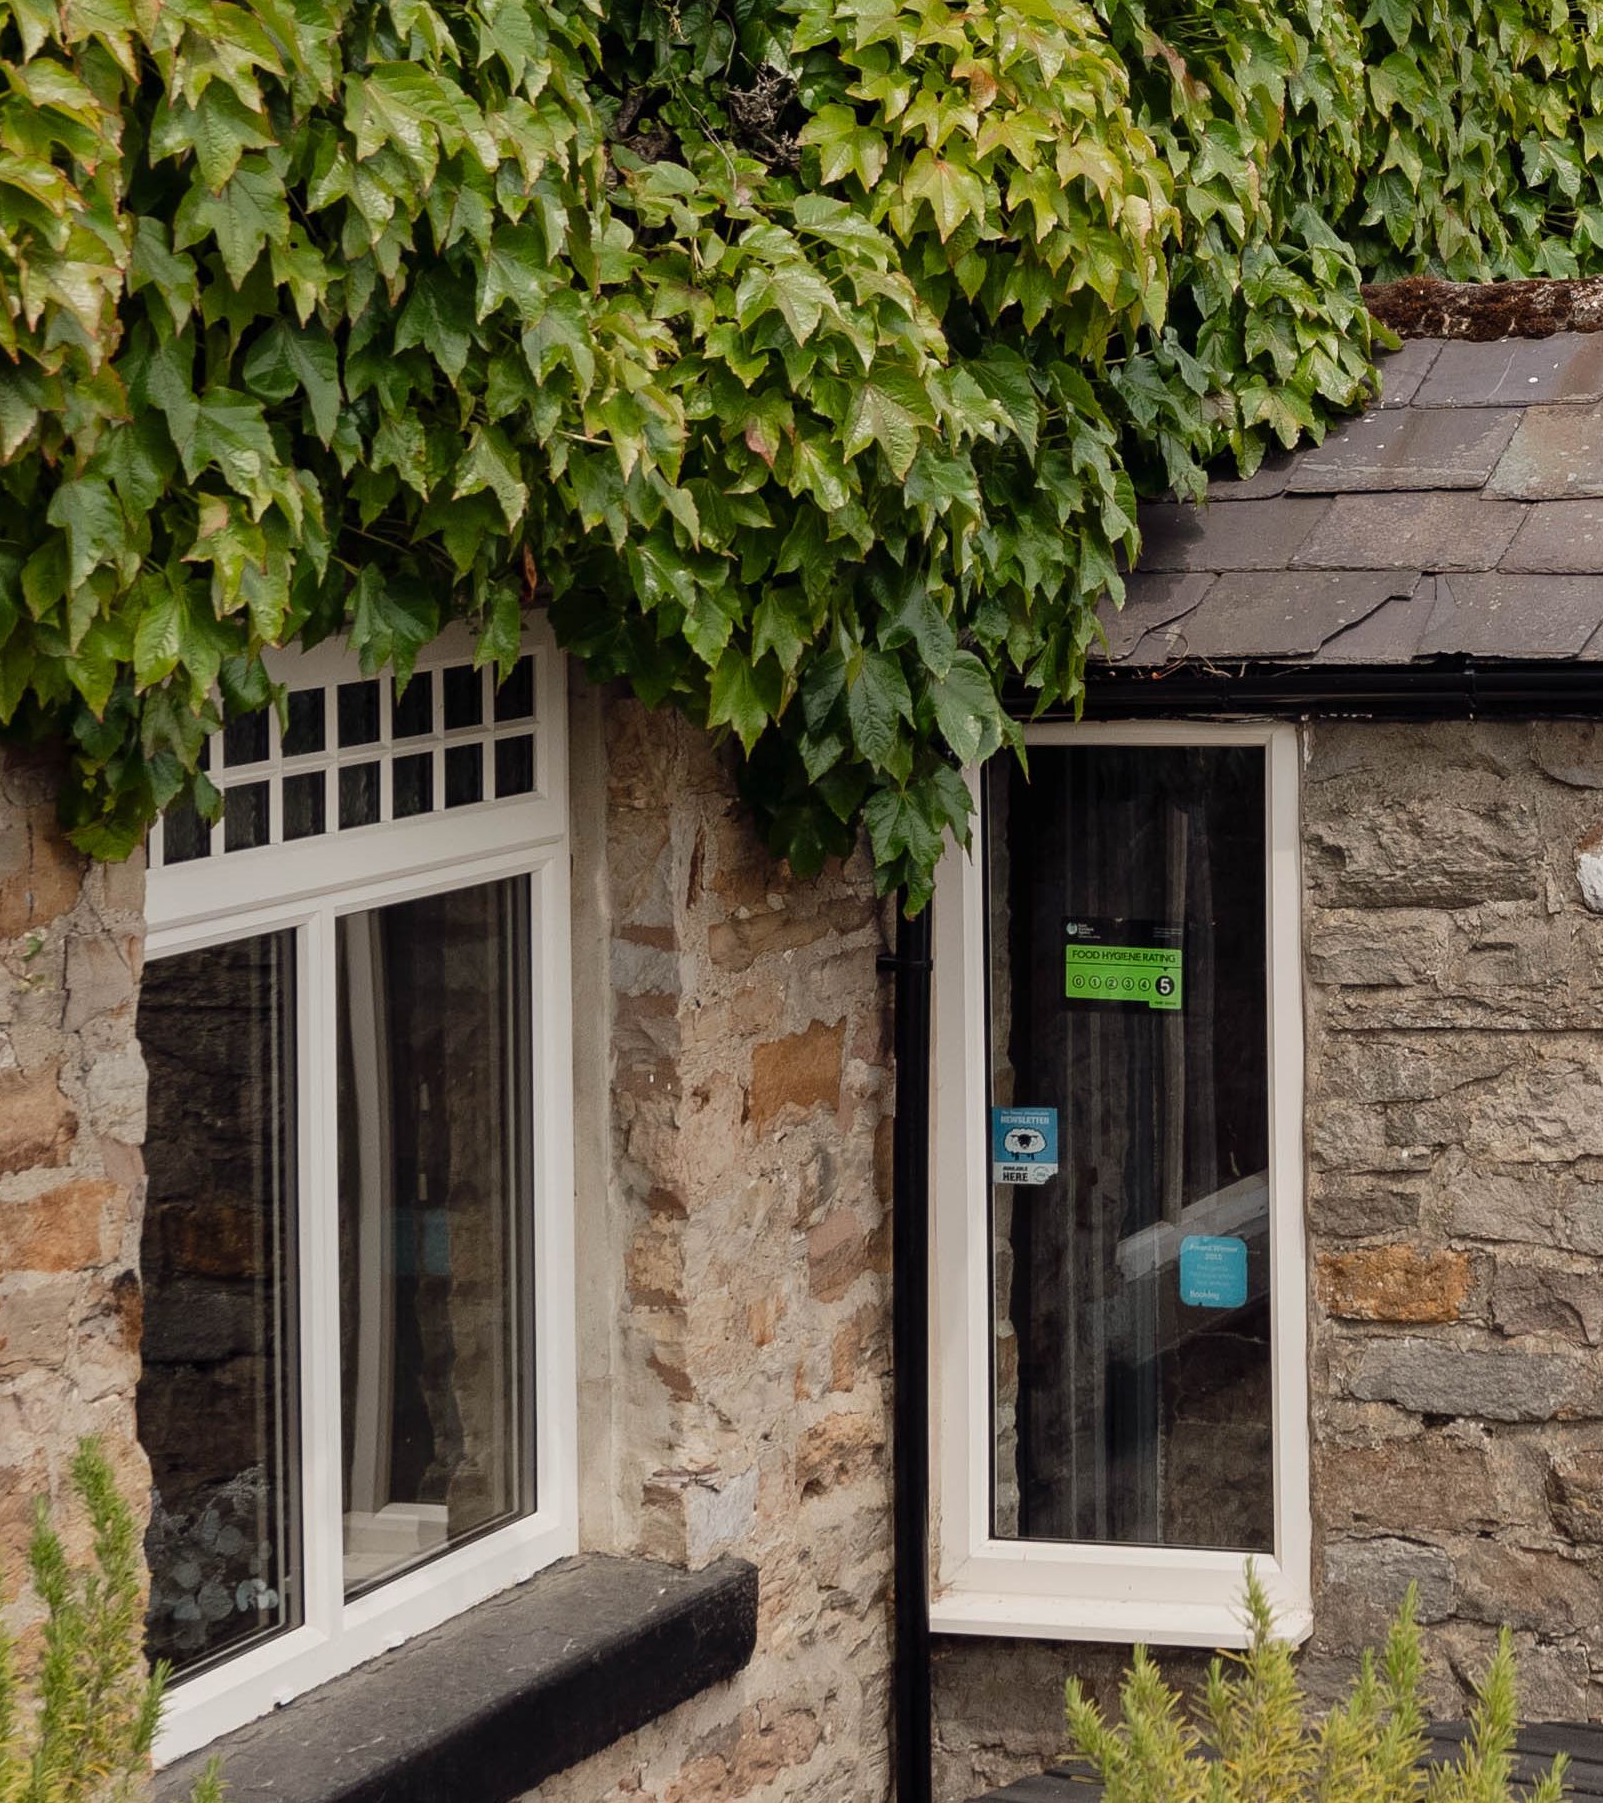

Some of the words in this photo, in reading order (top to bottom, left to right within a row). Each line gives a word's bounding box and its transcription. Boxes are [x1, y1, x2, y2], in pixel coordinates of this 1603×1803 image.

[1072, 949, 1100, 960] FOOD
[1102, 951, 1142, 962] HYGIENE
[1143, 953, 1176, 963] RATING
[1002, 1172, 1029, 1182] HERE
